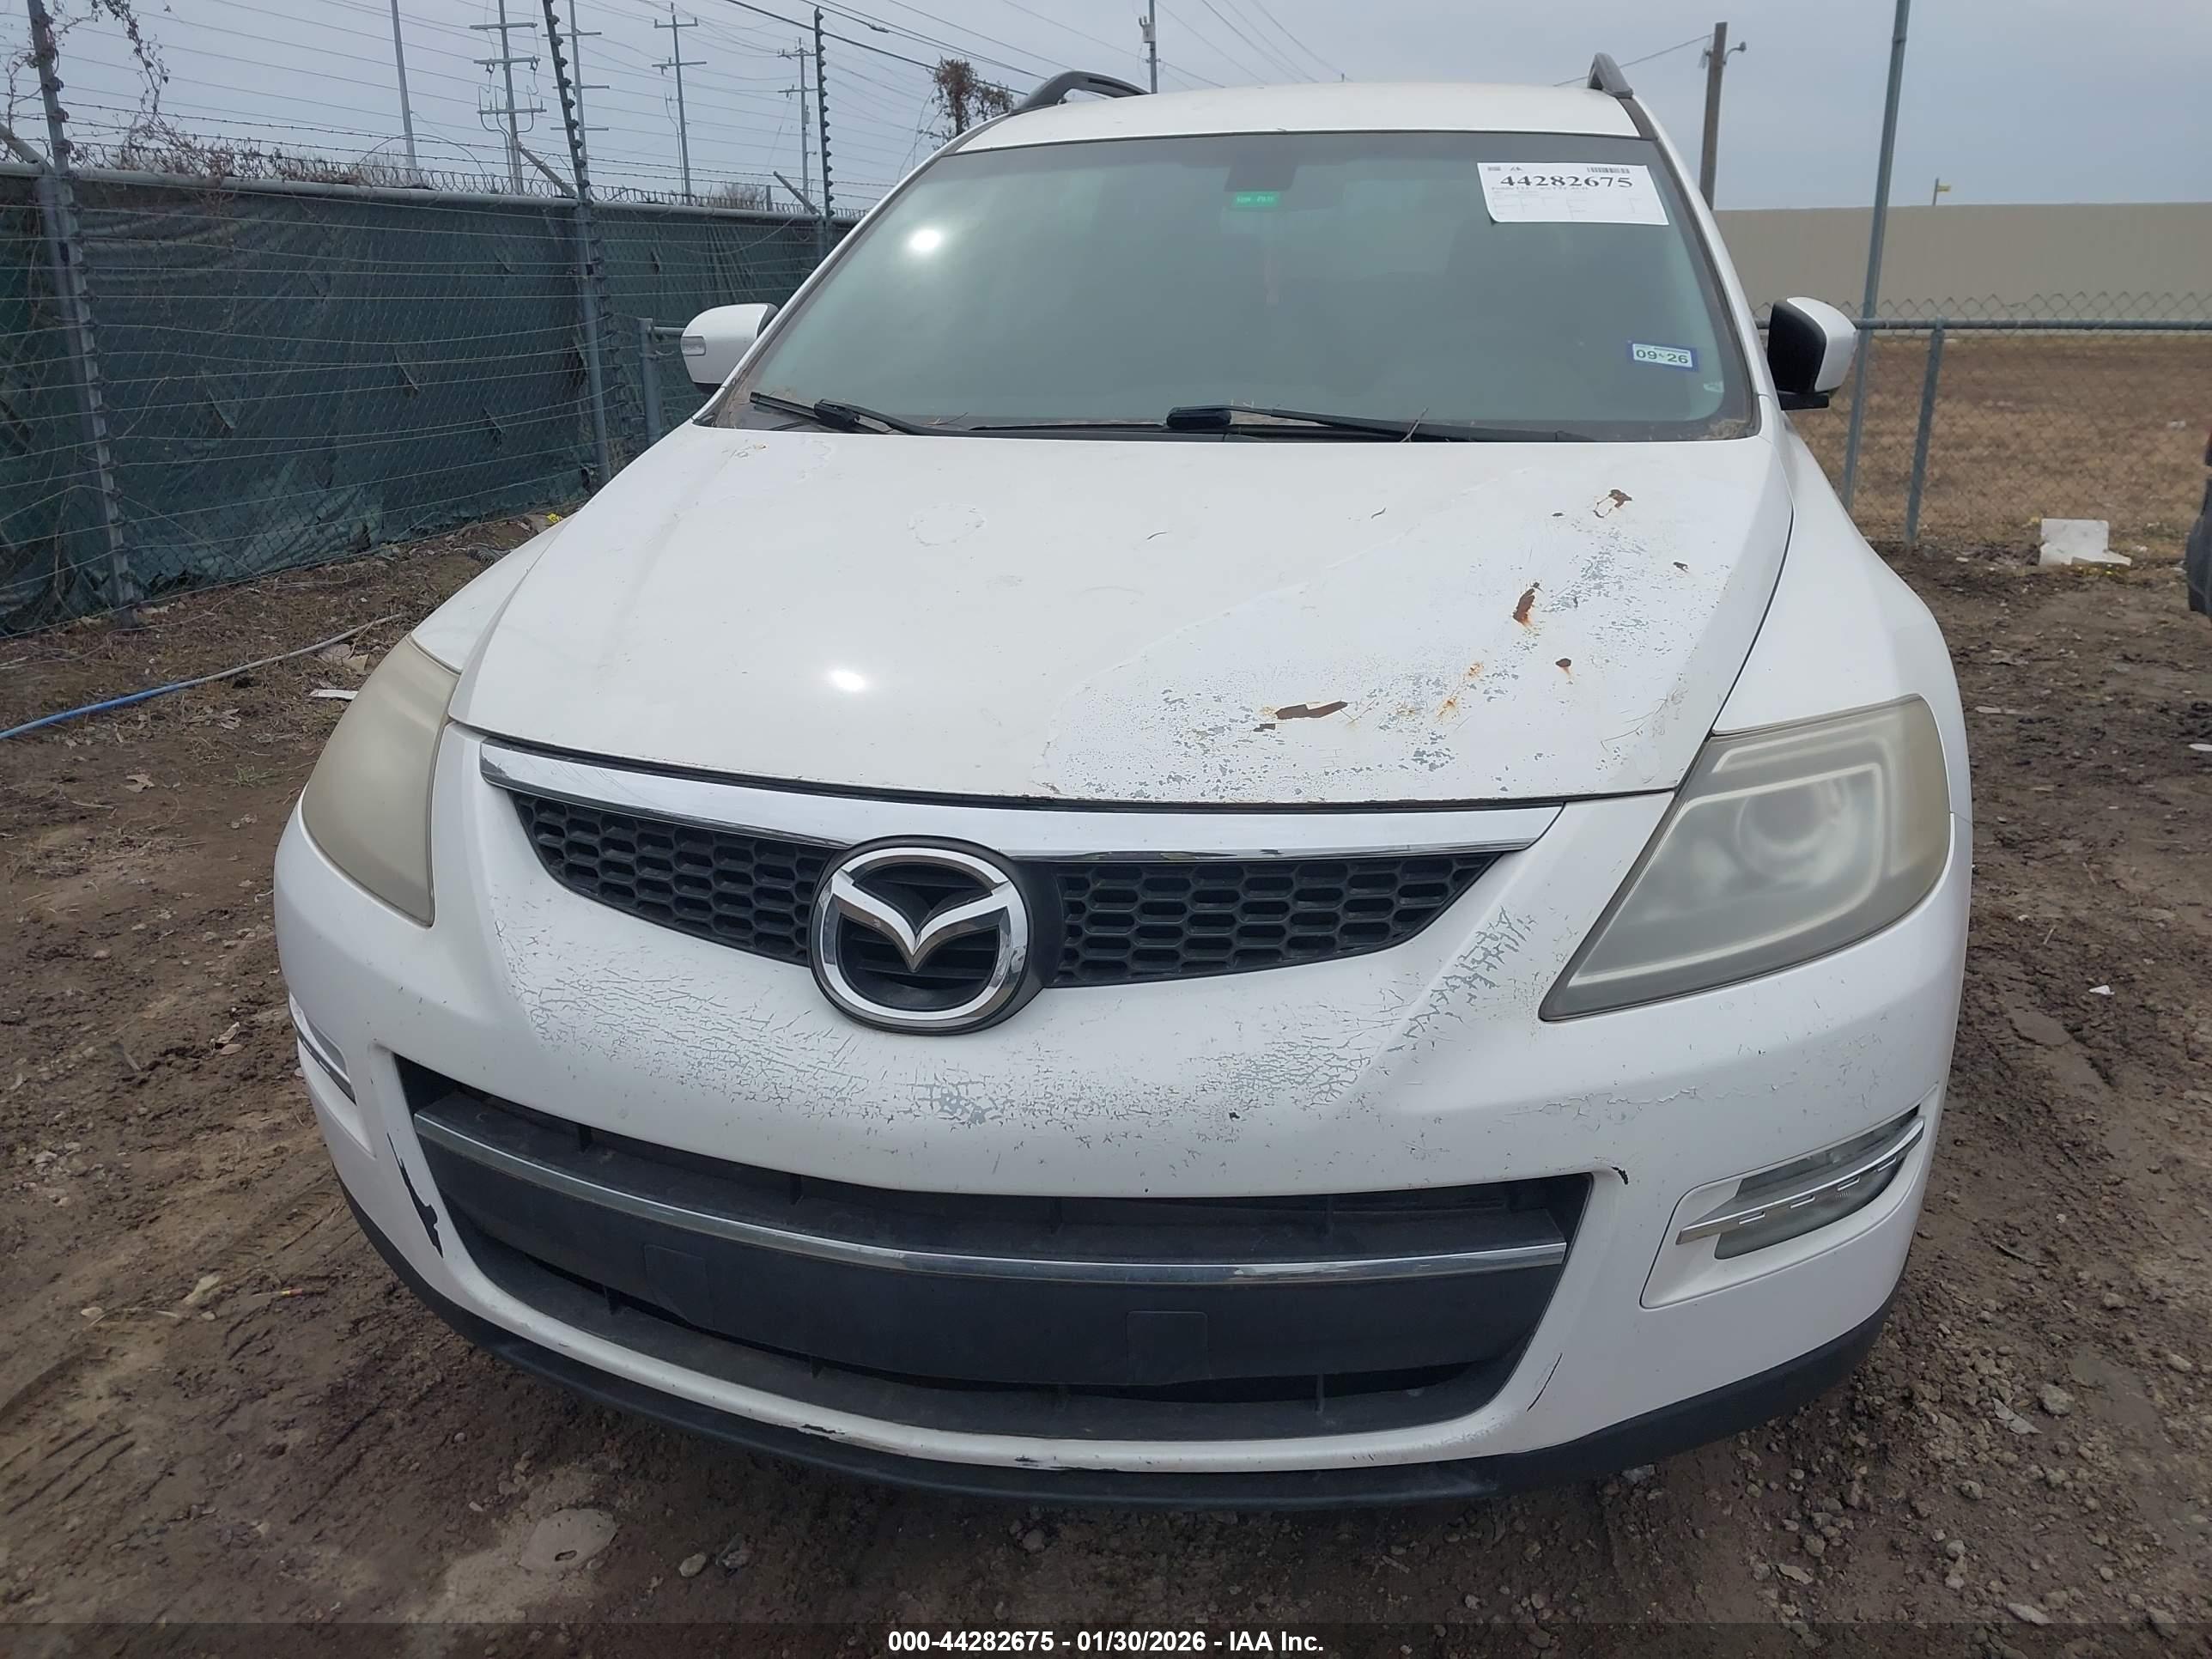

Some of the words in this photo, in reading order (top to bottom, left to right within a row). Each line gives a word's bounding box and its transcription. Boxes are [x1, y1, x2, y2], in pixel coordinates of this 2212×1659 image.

[1500, 175, 1633, 188] 44282675
[1635, 349, 1657, 360] 09
[1667, 353, 1689, 364] 26
